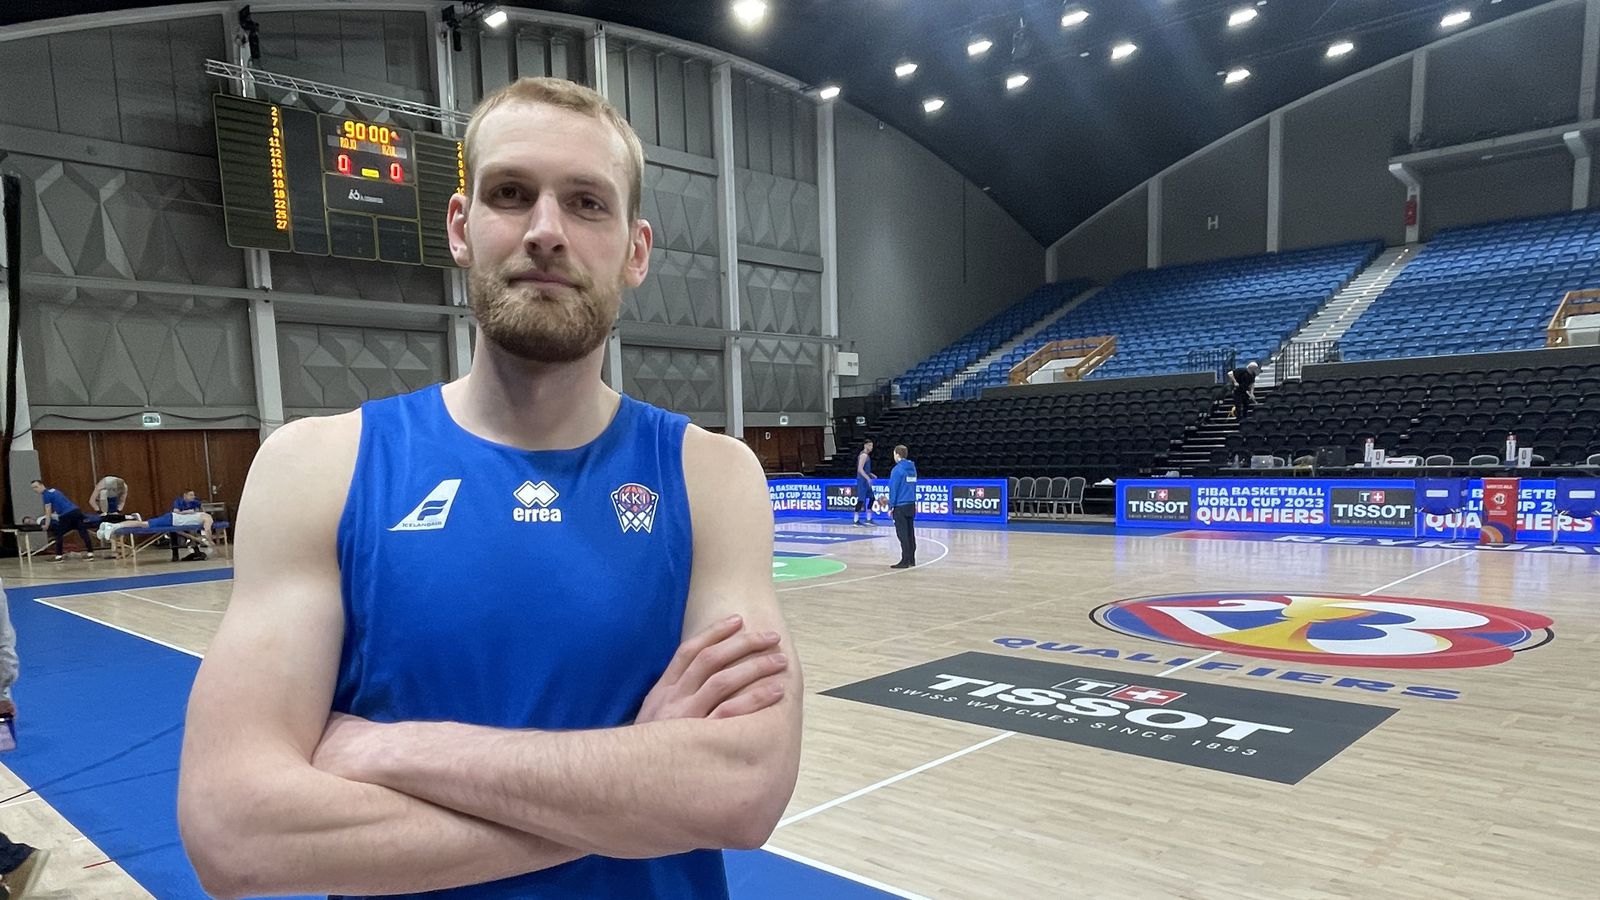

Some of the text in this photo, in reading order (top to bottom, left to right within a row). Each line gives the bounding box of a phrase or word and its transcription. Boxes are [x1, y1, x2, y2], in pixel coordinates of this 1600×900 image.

[271, 106, 278, 116] 2
[272, 116, 279, 126] 7
[269, 137, 280, 147] 11
[270, 148, 281, 158] 12
[271, 158, 282, 168] 13
[338, 154, 402, 181] 0 0
[274, 199, 286, 209] 22
[276, 219, 288, 229] 27
[1207, 215, 1219, 230] H
[775, 484, 822, 492] BASKETBALL
[915, 485, 949, 493] ETBALL
[1197, 486, 1325, 497] FIBA BASKETBALL
[770, 492, 822, 500] RLD CUP 2023
[826, 496, 859, 506] TISSO
[924, 493, 949, 501] 2023
[771, 499, 822, 511] ALIFIERS
[953, 498, 1000, 509] TISSOT
[1128, 500, 1189, 514] TISSOT
[1197, 497, 1325, 508] WORLD CUP 2023
[513, 507, 562, 522] errea
[1196, 507, 1325, 525] QUALIFIERS
[1333, 503, 1411, 519] TISSOT
[992, 637, 1461, 700] QUALIFIERS
[928, 673, 1295, 741] TISSOT
[888, 686, 1258, 757] SWISS WATCHES SINCE 1853
